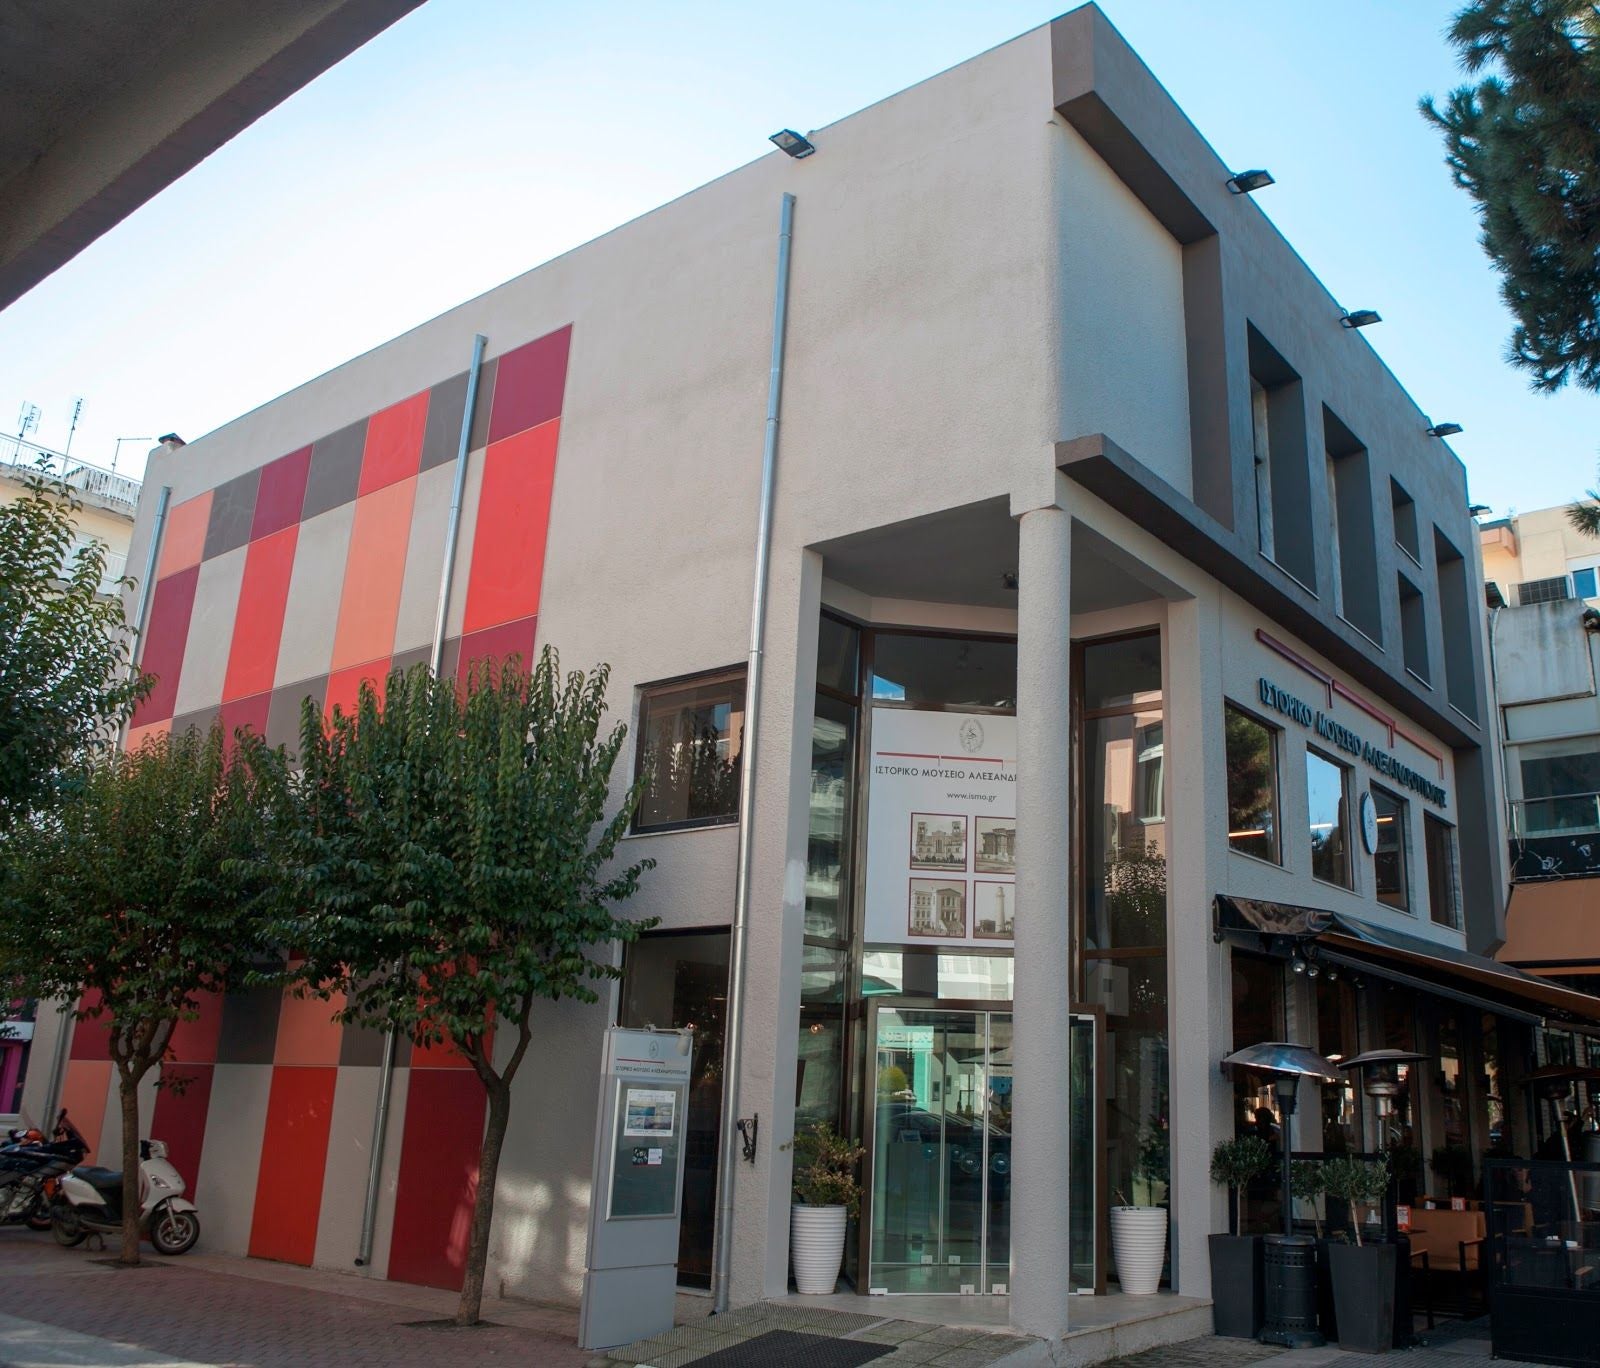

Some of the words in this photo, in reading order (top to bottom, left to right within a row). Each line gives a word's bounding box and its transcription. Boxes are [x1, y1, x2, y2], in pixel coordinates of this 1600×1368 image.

[1259, 677, 1312, 727] ΙΣΤΟΡΙΚΟ
[1316, 710, 1361, 756] ΜΟΥΣΕΙΟ
[875, 765, 919, 777] ΙΣΤΟΡΙΚΟ
[922, 768, 965, 779] ΜΟΥΣΕΙΟ
[946, 791, 997, 802] www.ismo.gr
